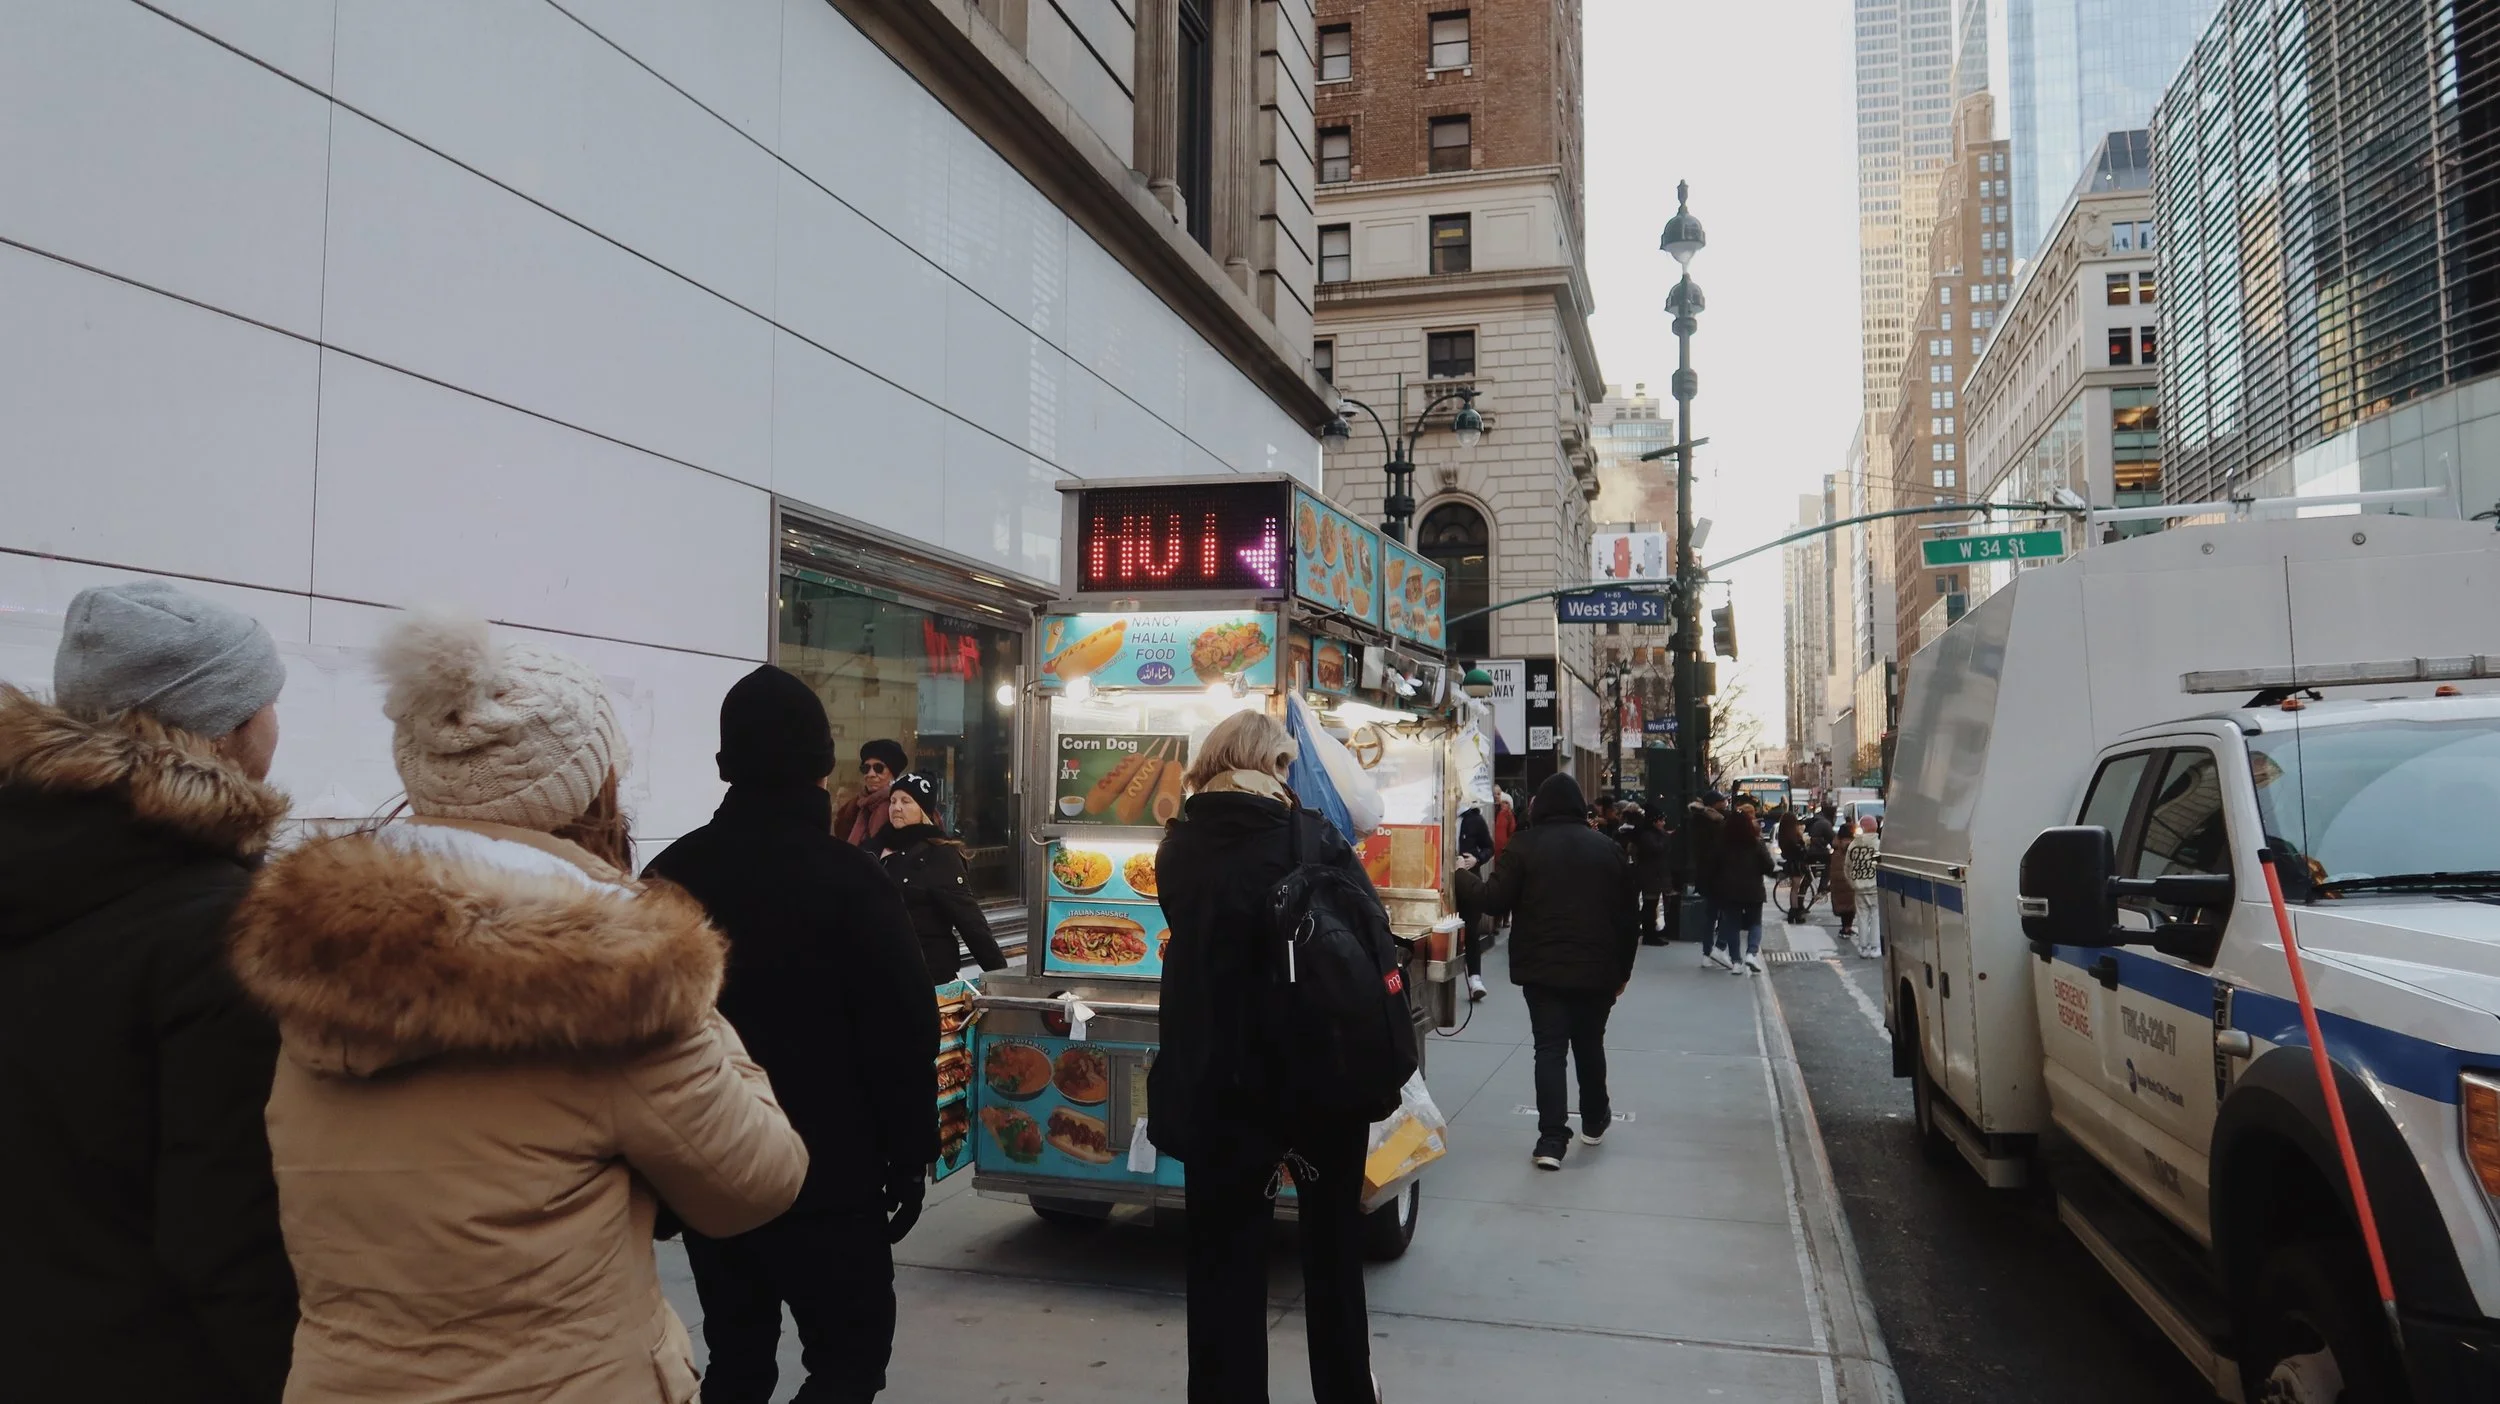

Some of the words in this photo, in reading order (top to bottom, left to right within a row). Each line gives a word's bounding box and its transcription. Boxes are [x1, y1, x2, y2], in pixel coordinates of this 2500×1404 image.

[1959, 542, 1972, 559] W
[1979, 540, 2001, 557] 34
[2008, 538, 2026, 554] St
[1568, 602, 1606, 616] West
[1610, 600, 1638, 616] 34th
[1641, 601, 1657, 616] St
[1132, 616, 1181, 627] NANCY
[1131, 632, 1177, 643] HALAL
[1135, 648, 1175, 660] FOOD
[1648, 723, 1665, 731] West
[1061, 737, 1100, 750] Corn
[1106, 737, 1138, 753] Dog
[1060, 769, 1080, 780] NY
[1376, 827, 1392, 836] Do
[1851, 867, 1875, 880] 2022
[1068, 909, 1095, 917] ITALIAN
[1096, 910, 1129, 919] SAUSAGE
[2054, 978, 2089, 1010] EMERGENCY
